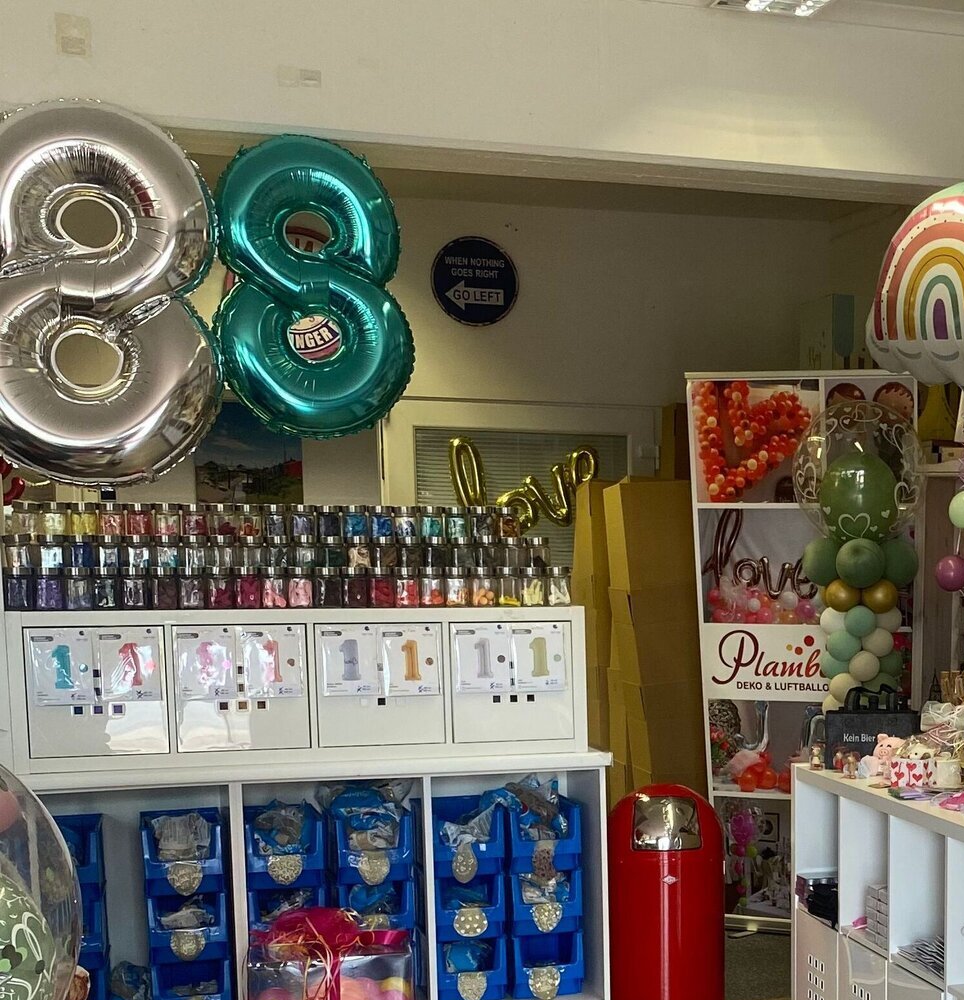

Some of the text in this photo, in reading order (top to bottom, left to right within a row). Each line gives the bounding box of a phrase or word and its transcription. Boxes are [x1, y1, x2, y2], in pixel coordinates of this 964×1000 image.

[445, 256, 505, 268] WHEN NOTHING
[451, 268, 499, 279] GOES RIGHT
[453, 290, 500, 302] GO LEFT
[401, 640, 421, 681] 1
[474, 638, 493, 679] 1
[529, 637, 549, 677] 1
[711, 629, 824, 685] Plamb
[736, 681, 763, 691] DEKO
[765, 682, 772, 691] &
[843, 733, 876, 742] Kein Bier
